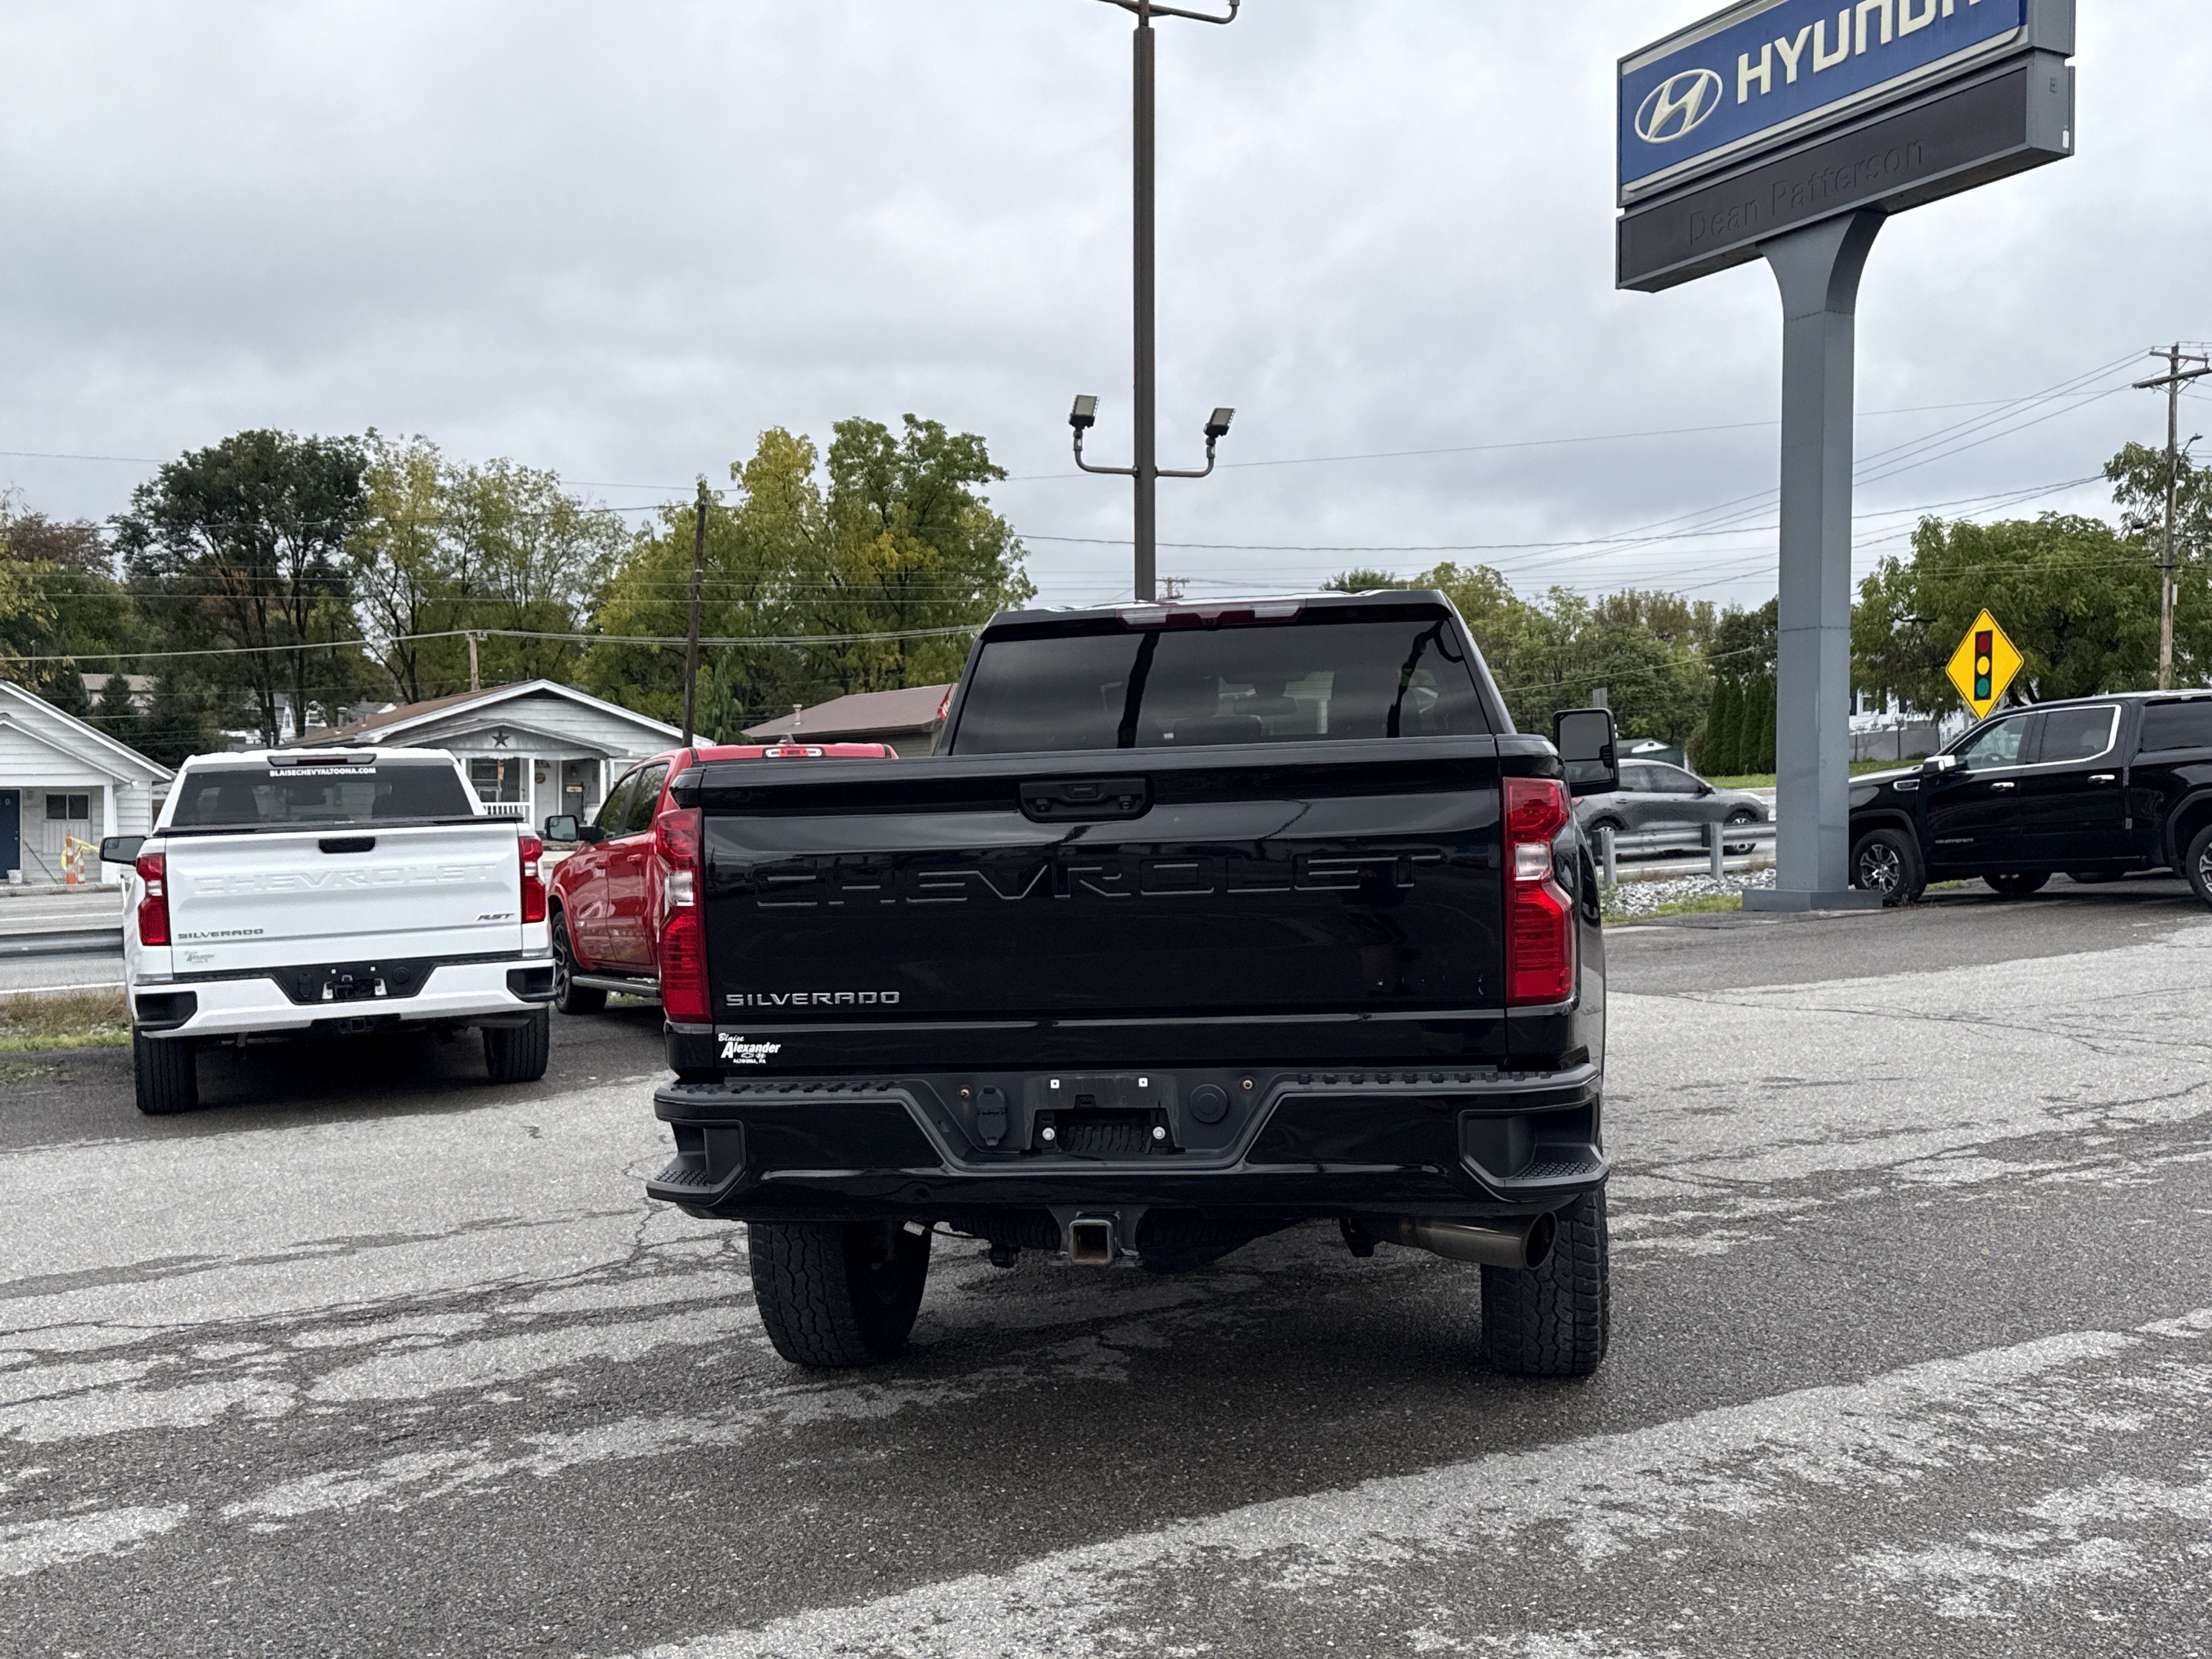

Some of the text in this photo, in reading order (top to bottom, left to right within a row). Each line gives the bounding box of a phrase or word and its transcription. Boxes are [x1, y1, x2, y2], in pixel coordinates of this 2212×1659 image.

[1737, 0, 1982, 104] HYUND
[1690, 139, 1923, 245] Dean Patterson
[269, 767, 376, 777] BLAISECHEVYALTOONA.COM
[193, 863, 497, 894] CHEVROLET
[754, 850, 1441, 906] CHEVROLET
[476, 912, 515, 922] RST
[178, 928, 264, 939] SILVERADO
[726, 991, 900, 1006] SILVERADO
[718, 1032, 745, 1042] Blaise
[720, 1041, 782, 1058] Alexander
